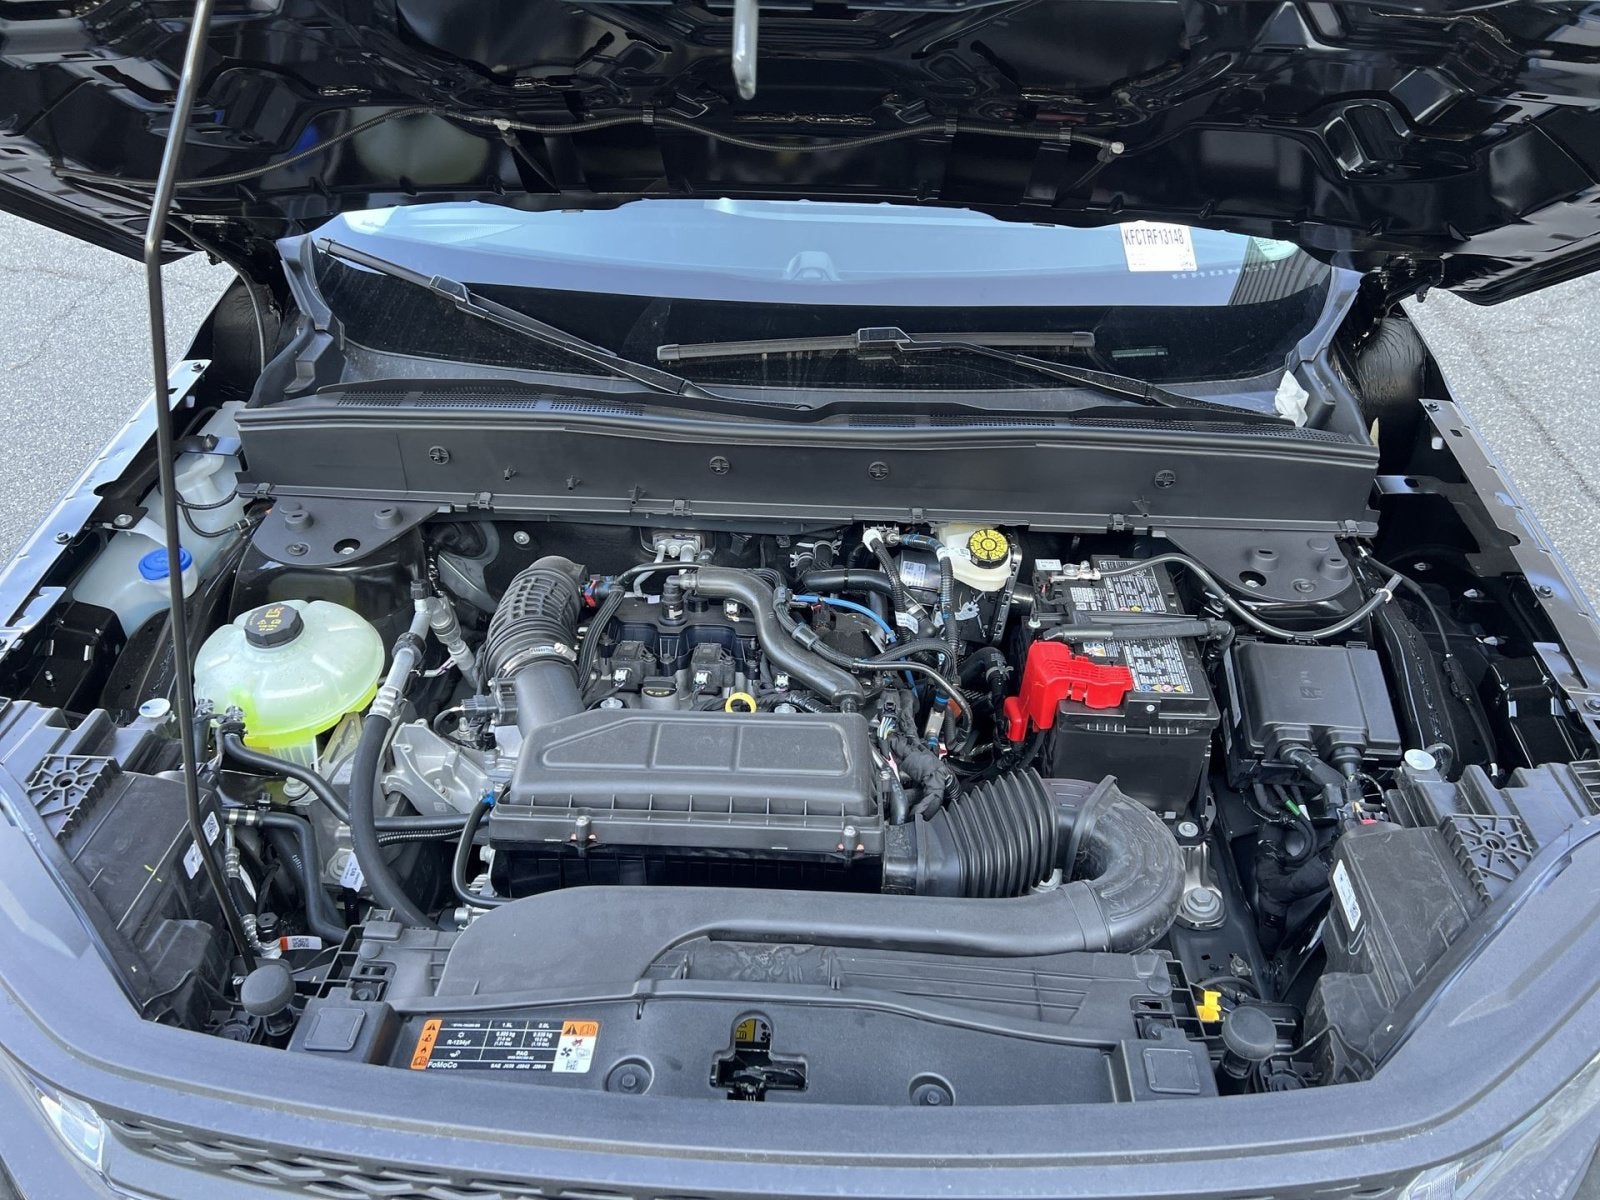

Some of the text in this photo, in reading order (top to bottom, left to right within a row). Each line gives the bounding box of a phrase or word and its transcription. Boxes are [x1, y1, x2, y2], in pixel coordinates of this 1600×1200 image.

[1123, 228, 1184, 246] KFCTRF13148
[509, 1031, 516, 1039] kg
[446, 1039, 472, 1047] R-1234yf
[427, 1061, 458, 1069] FoMoCo
